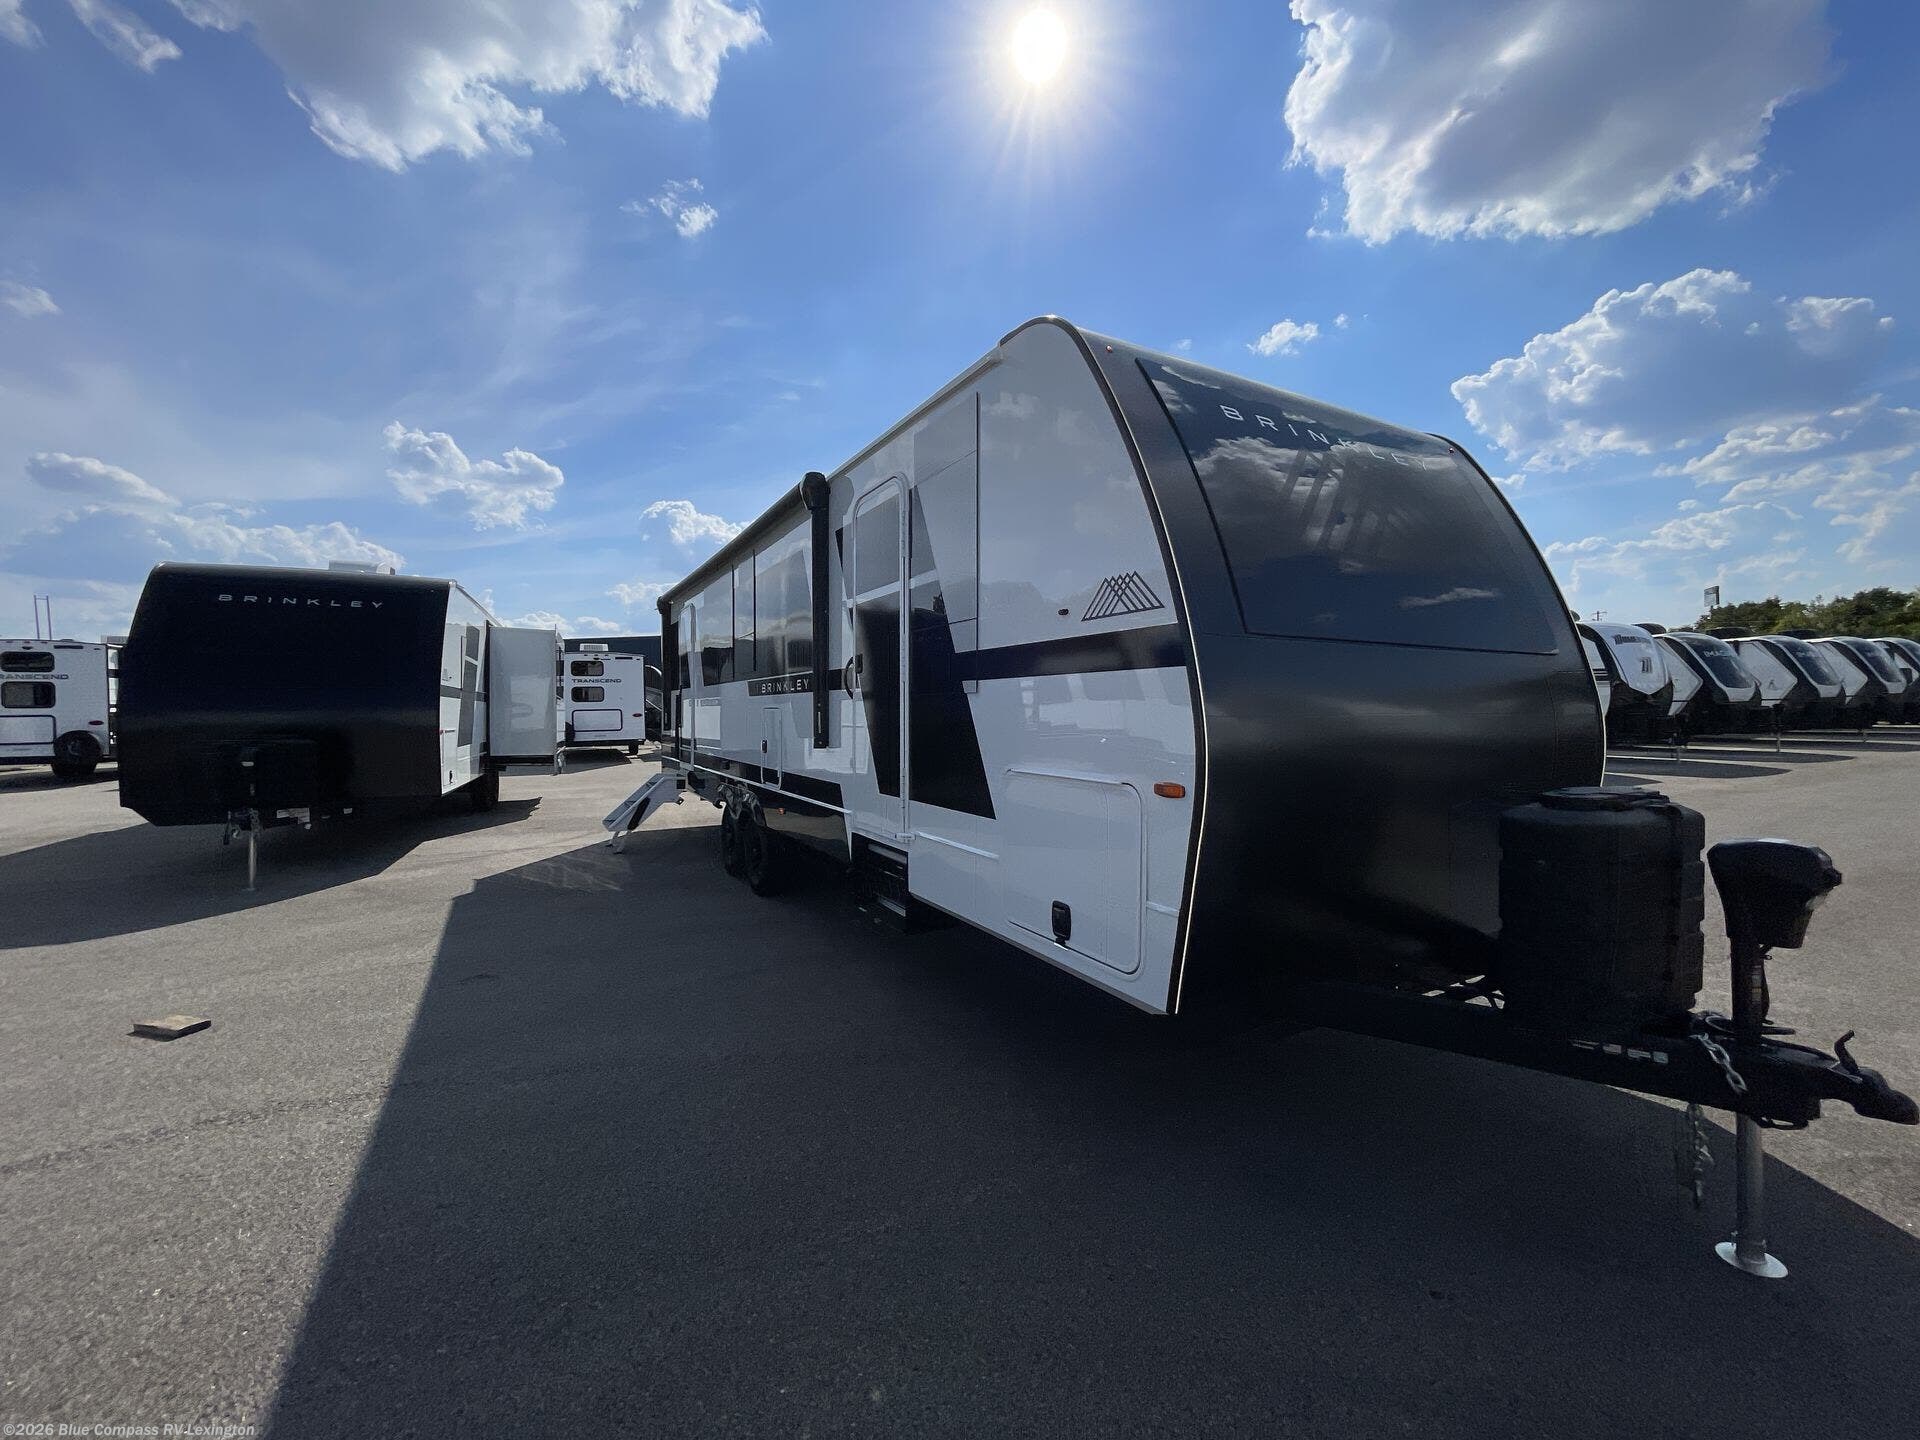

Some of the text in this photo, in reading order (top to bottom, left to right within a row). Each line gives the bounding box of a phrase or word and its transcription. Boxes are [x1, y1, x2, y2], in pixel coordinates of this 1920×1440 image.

[1219, 404, 1428, 471] BRINKLEY
[218, 594, 383, 608] BRINKLEY
[761, 678, 809, 694] BRINKLEY
